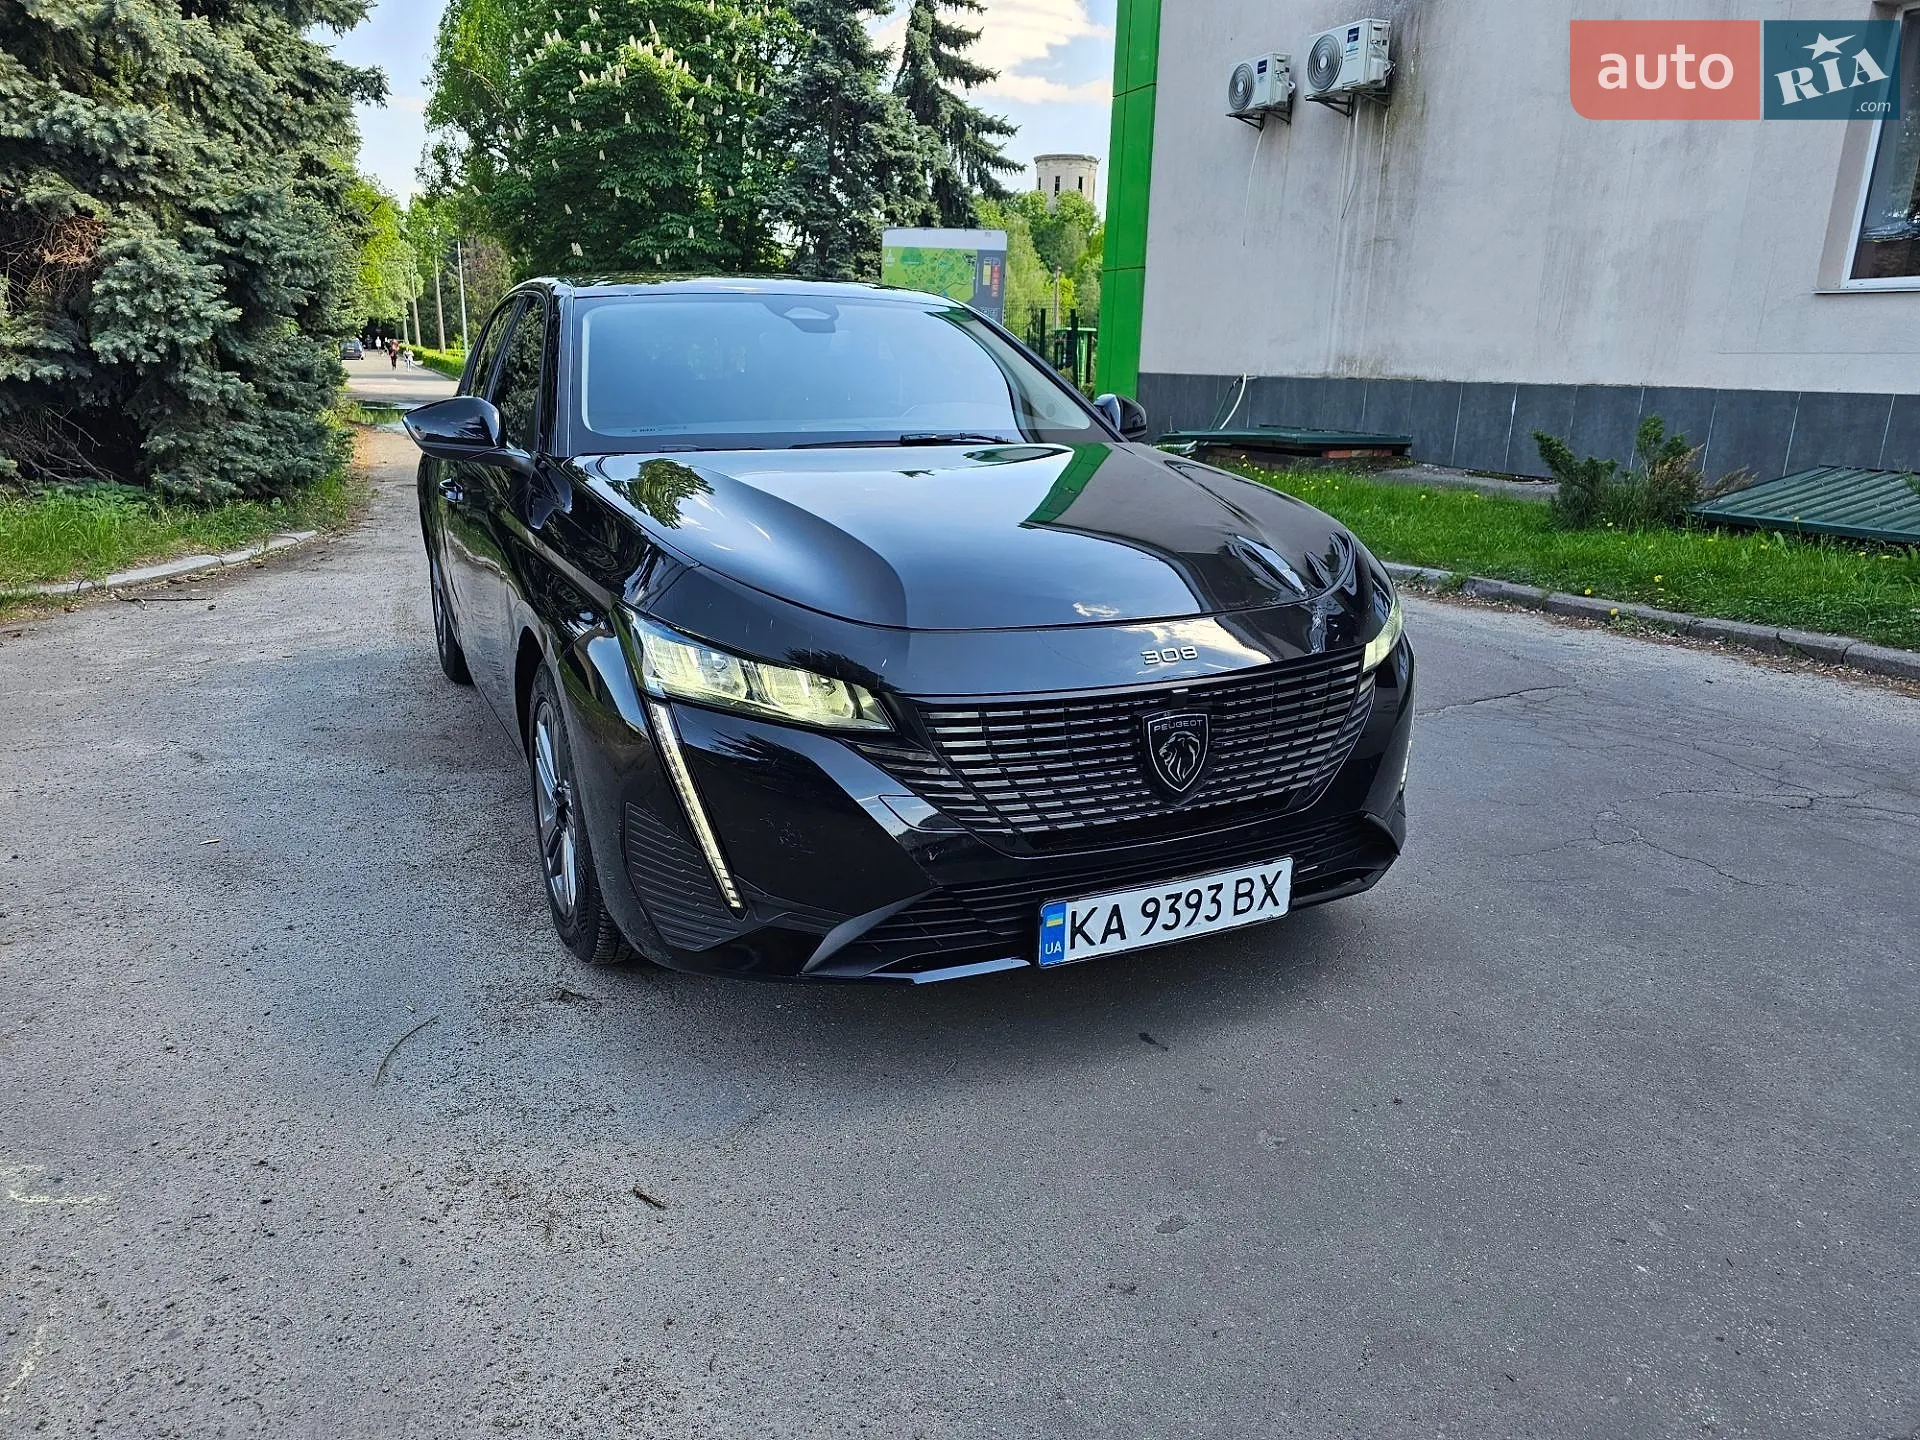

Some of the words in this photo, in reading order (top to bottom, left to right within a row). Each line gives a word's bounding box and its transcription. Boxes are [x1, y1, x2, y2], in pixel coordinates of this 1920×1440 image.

[1141, 646, 1198, 665] 308
[1153, 719, 1203, 732] PEUGEOT
[1069, 903, 1127, 950] KA
[1140, 882, 1224, 937] 9393
[1233, 870, 1283, 917] BX
[1045, 942, 1062, 955] UA
